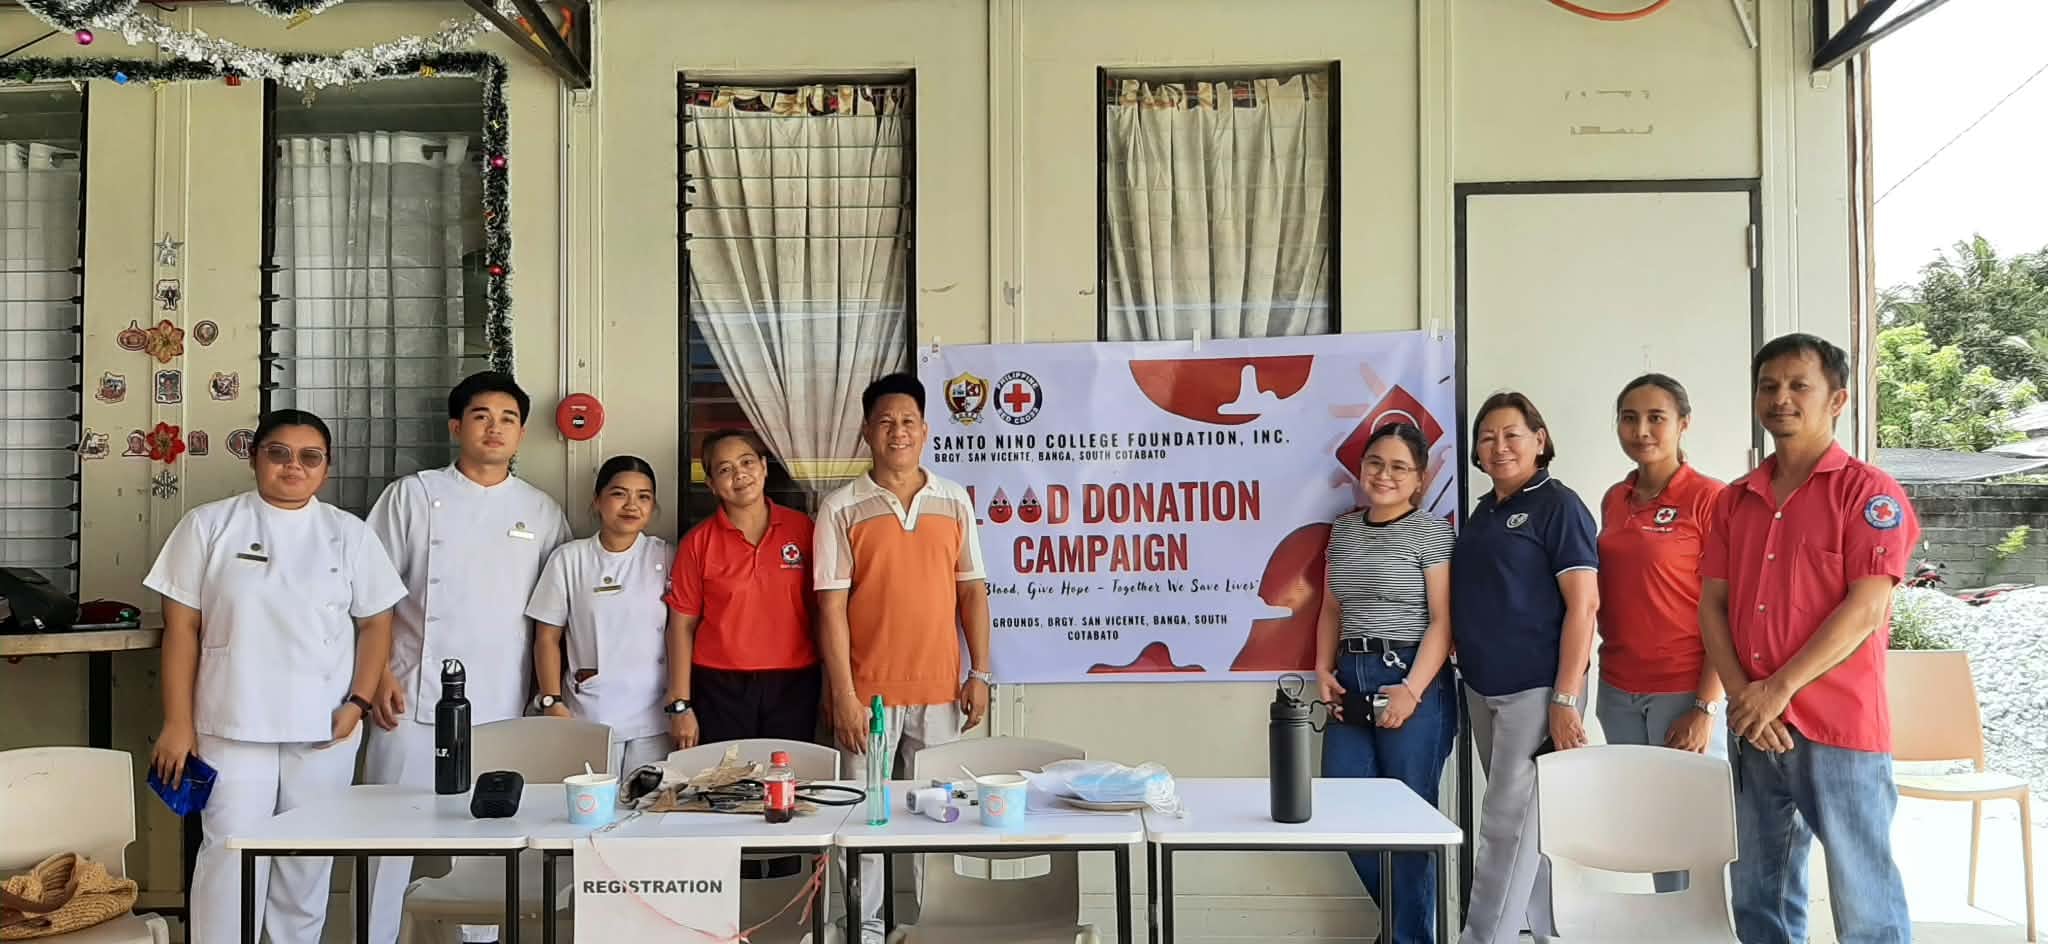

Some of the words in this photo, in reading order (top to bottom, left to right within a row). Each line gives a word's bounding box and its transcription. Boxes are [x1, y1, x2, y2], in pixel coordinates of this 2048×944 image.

[997, 371, 1039, 389] PHILIPPINE
[1014, 407, 1039, 424] CROSS
[933, 435, 986, 450] SANTO
[996, 434, 1036, 449] NINO
[1046, 433, 1118, 449] COLLEGE
[1128, 430, 1244, 448] FOUNDATION,
[1254, 429, 1290, 445] INC.
[934, 452, 964, 463] BRGY.
[968, 452, 986, 462] SAN
[991, 451, 1034, 463] VICENTE,
[1038, 451, 1075, 462] BANGA,
[1079, 450, 1111, 461] SOUTH
[1115, 449, 1166, 460] COTABATO
[1082, 480, 1260, 525] DONATION
[1013, 533, 1188, 574] CAMPAIGN
[1027, 581, 1055, 600] Give
[1061, 580, 1089, 596] Hope
[1112, 579, 1160, 596] Together
[1168, 578, 1185, 593] We
[1191, 578, 1219, 593] Save
[992, 617, 1043, 629] GROUNDS,
[1082, 616, 1101, 626] SAN
[1105, 615, 1149, 627] VICENTE,
[1153, 615, 1190, 626] BANGA,
[1194, 614, 1227, 625] SOUTH
[1067, 629, 1119, 641] COTABATO
[583, 880, 723, 894] REGISTRATION
